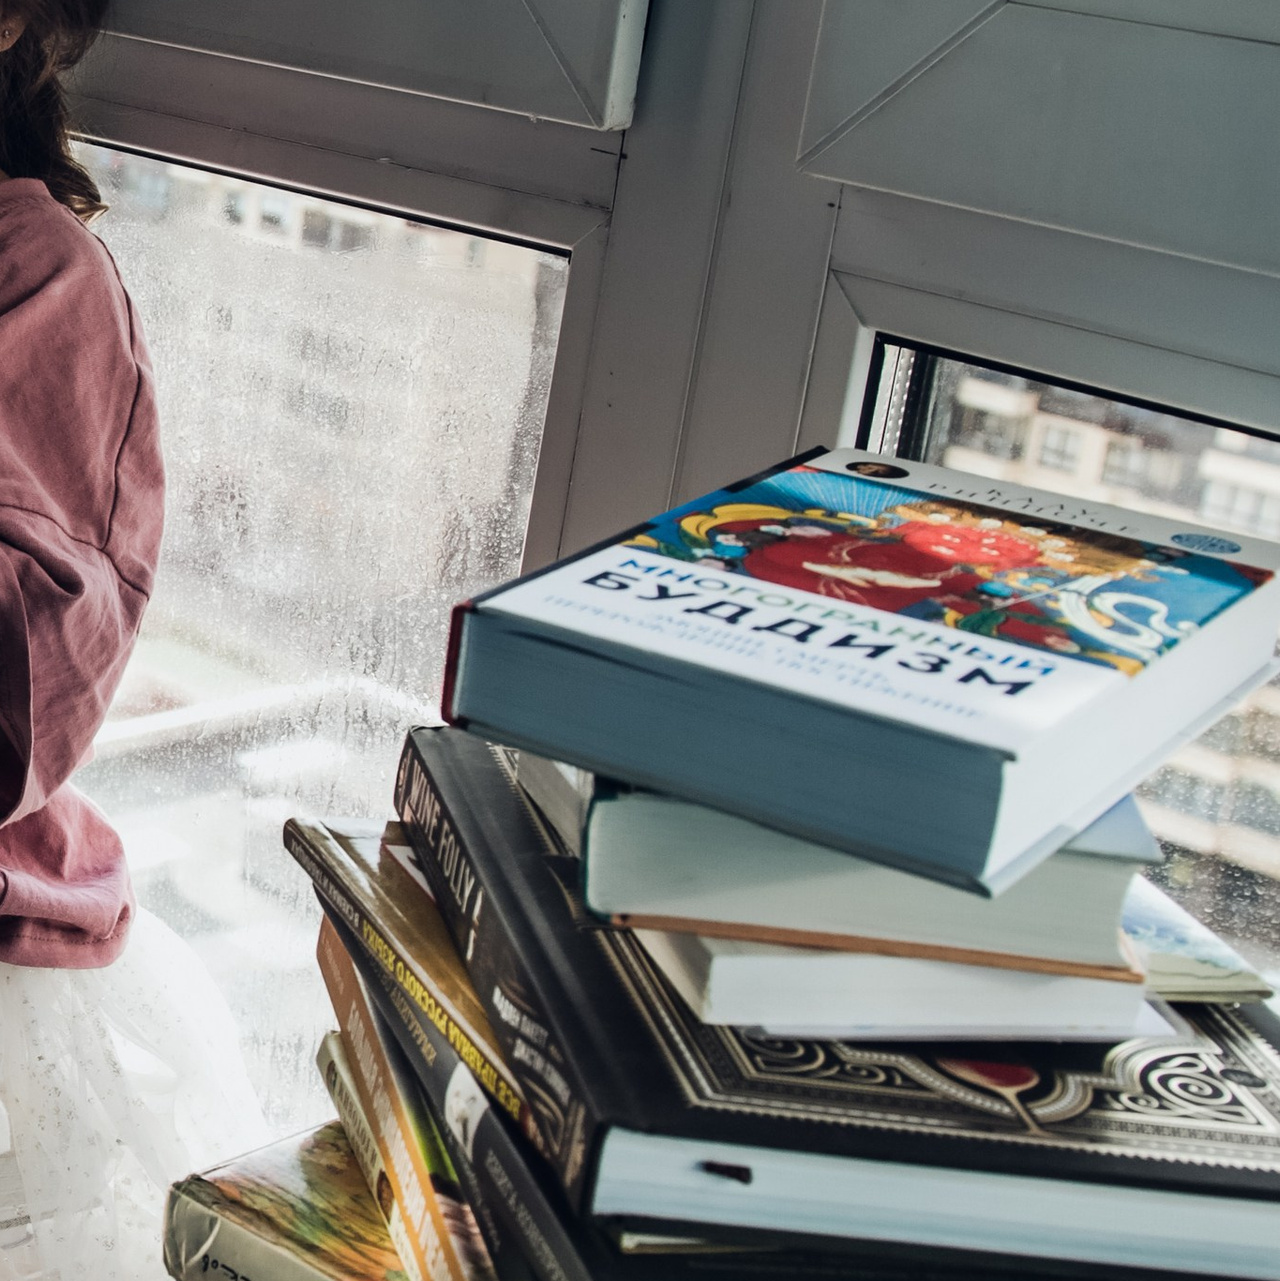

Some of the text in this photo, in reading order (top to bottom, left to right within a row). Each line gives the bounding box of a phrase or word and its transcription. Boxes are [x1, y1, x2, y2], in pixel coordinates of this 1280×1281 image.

[582, 570, 1035, 696] БУДДИЗМ
[618, 558, 1056, 676] МНОГОГРАННЫЙ
[410, 758, 476, 914] WINE FOLLY
[363, 919, 396, 972] ЯЗЫКА
[396, 961, 449, 1036] РУССКОГО
[448, 1020, 498, 1094] ПРАВИЛА
[496, 1081, 521, 1121] ВСЕ
